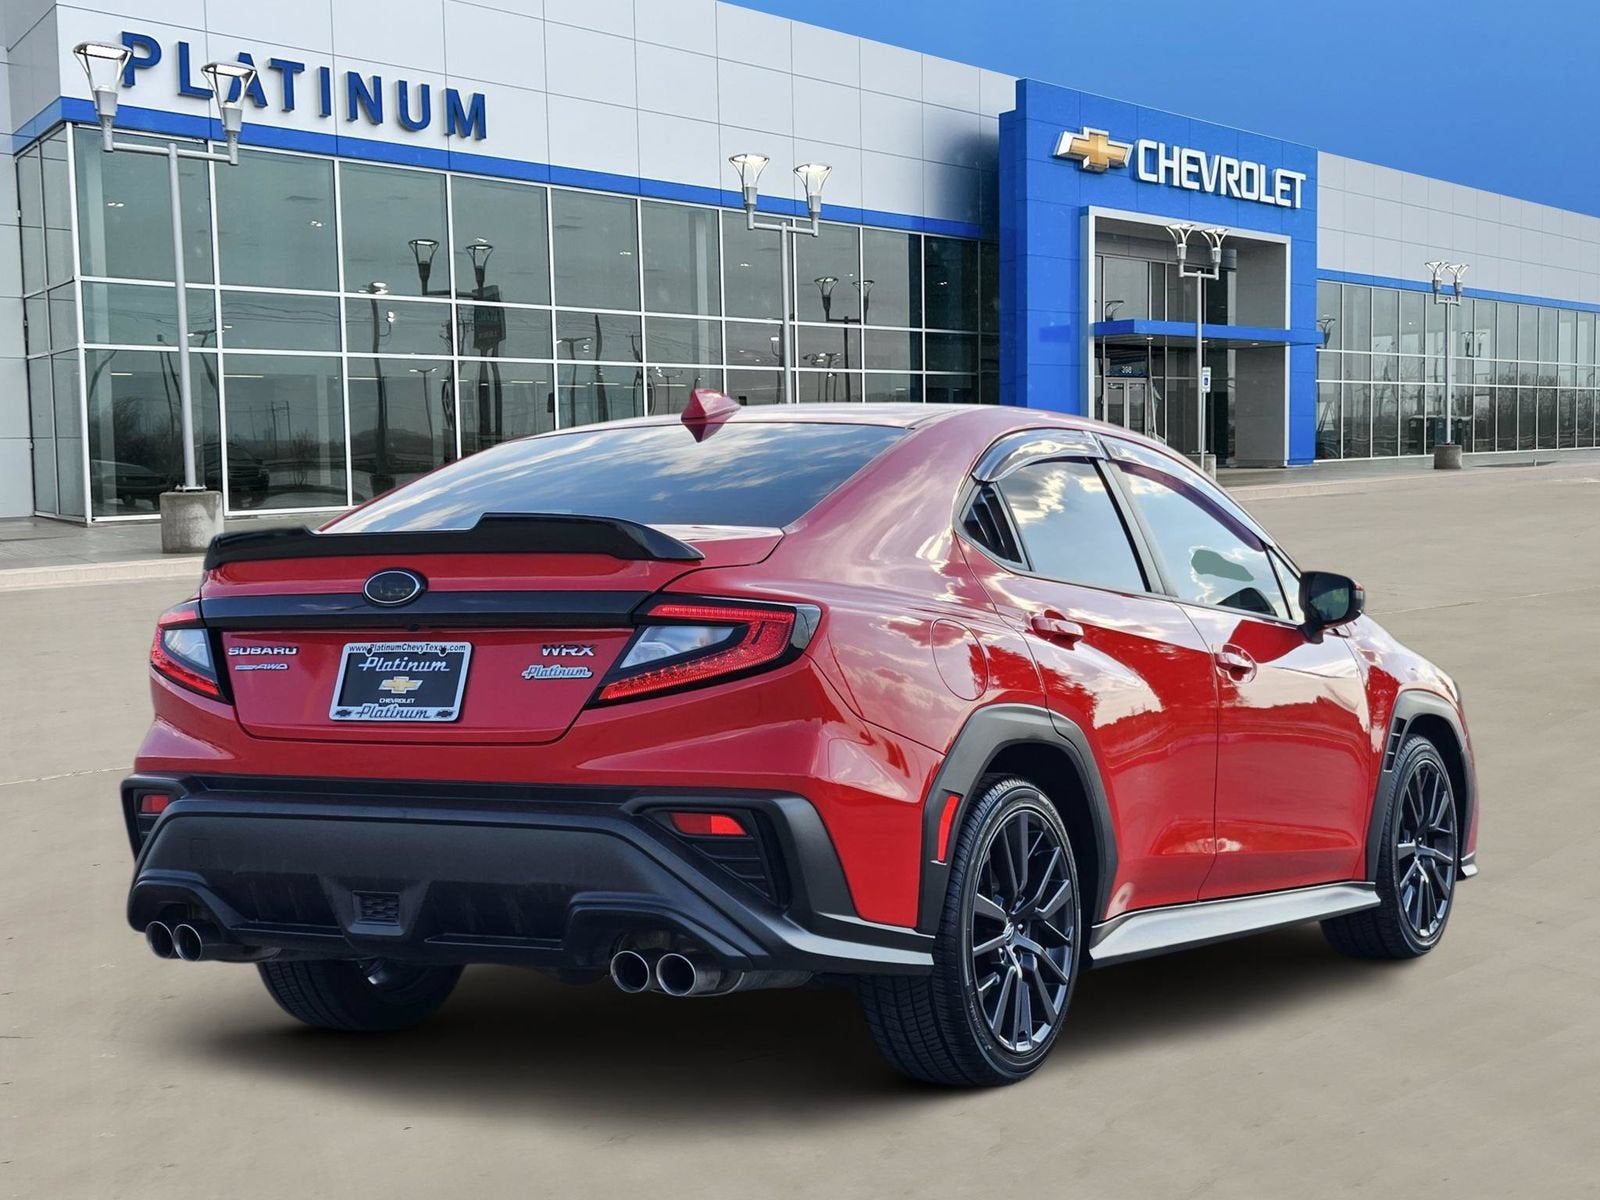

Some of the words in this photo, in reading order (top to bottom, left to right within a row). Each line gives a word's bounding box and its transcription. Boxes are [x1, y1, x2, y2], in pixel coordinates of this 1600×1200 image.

[120, 31, 487, 141] PLATINUM
[1135, 138, 1306, 209] CHEVROLET
[227, 646, 298, 656] SUBARU
[349, 643, 466, 652] wwwPlatinumChevyTex.com
[541, 644, 596, 657] WRX
[255, 663, 289, 671] AWD
[358, 656, 451, 672] Platinum
[521, 664, 593, 679] Platinum
[355, 704, 431, 719] Platinum
